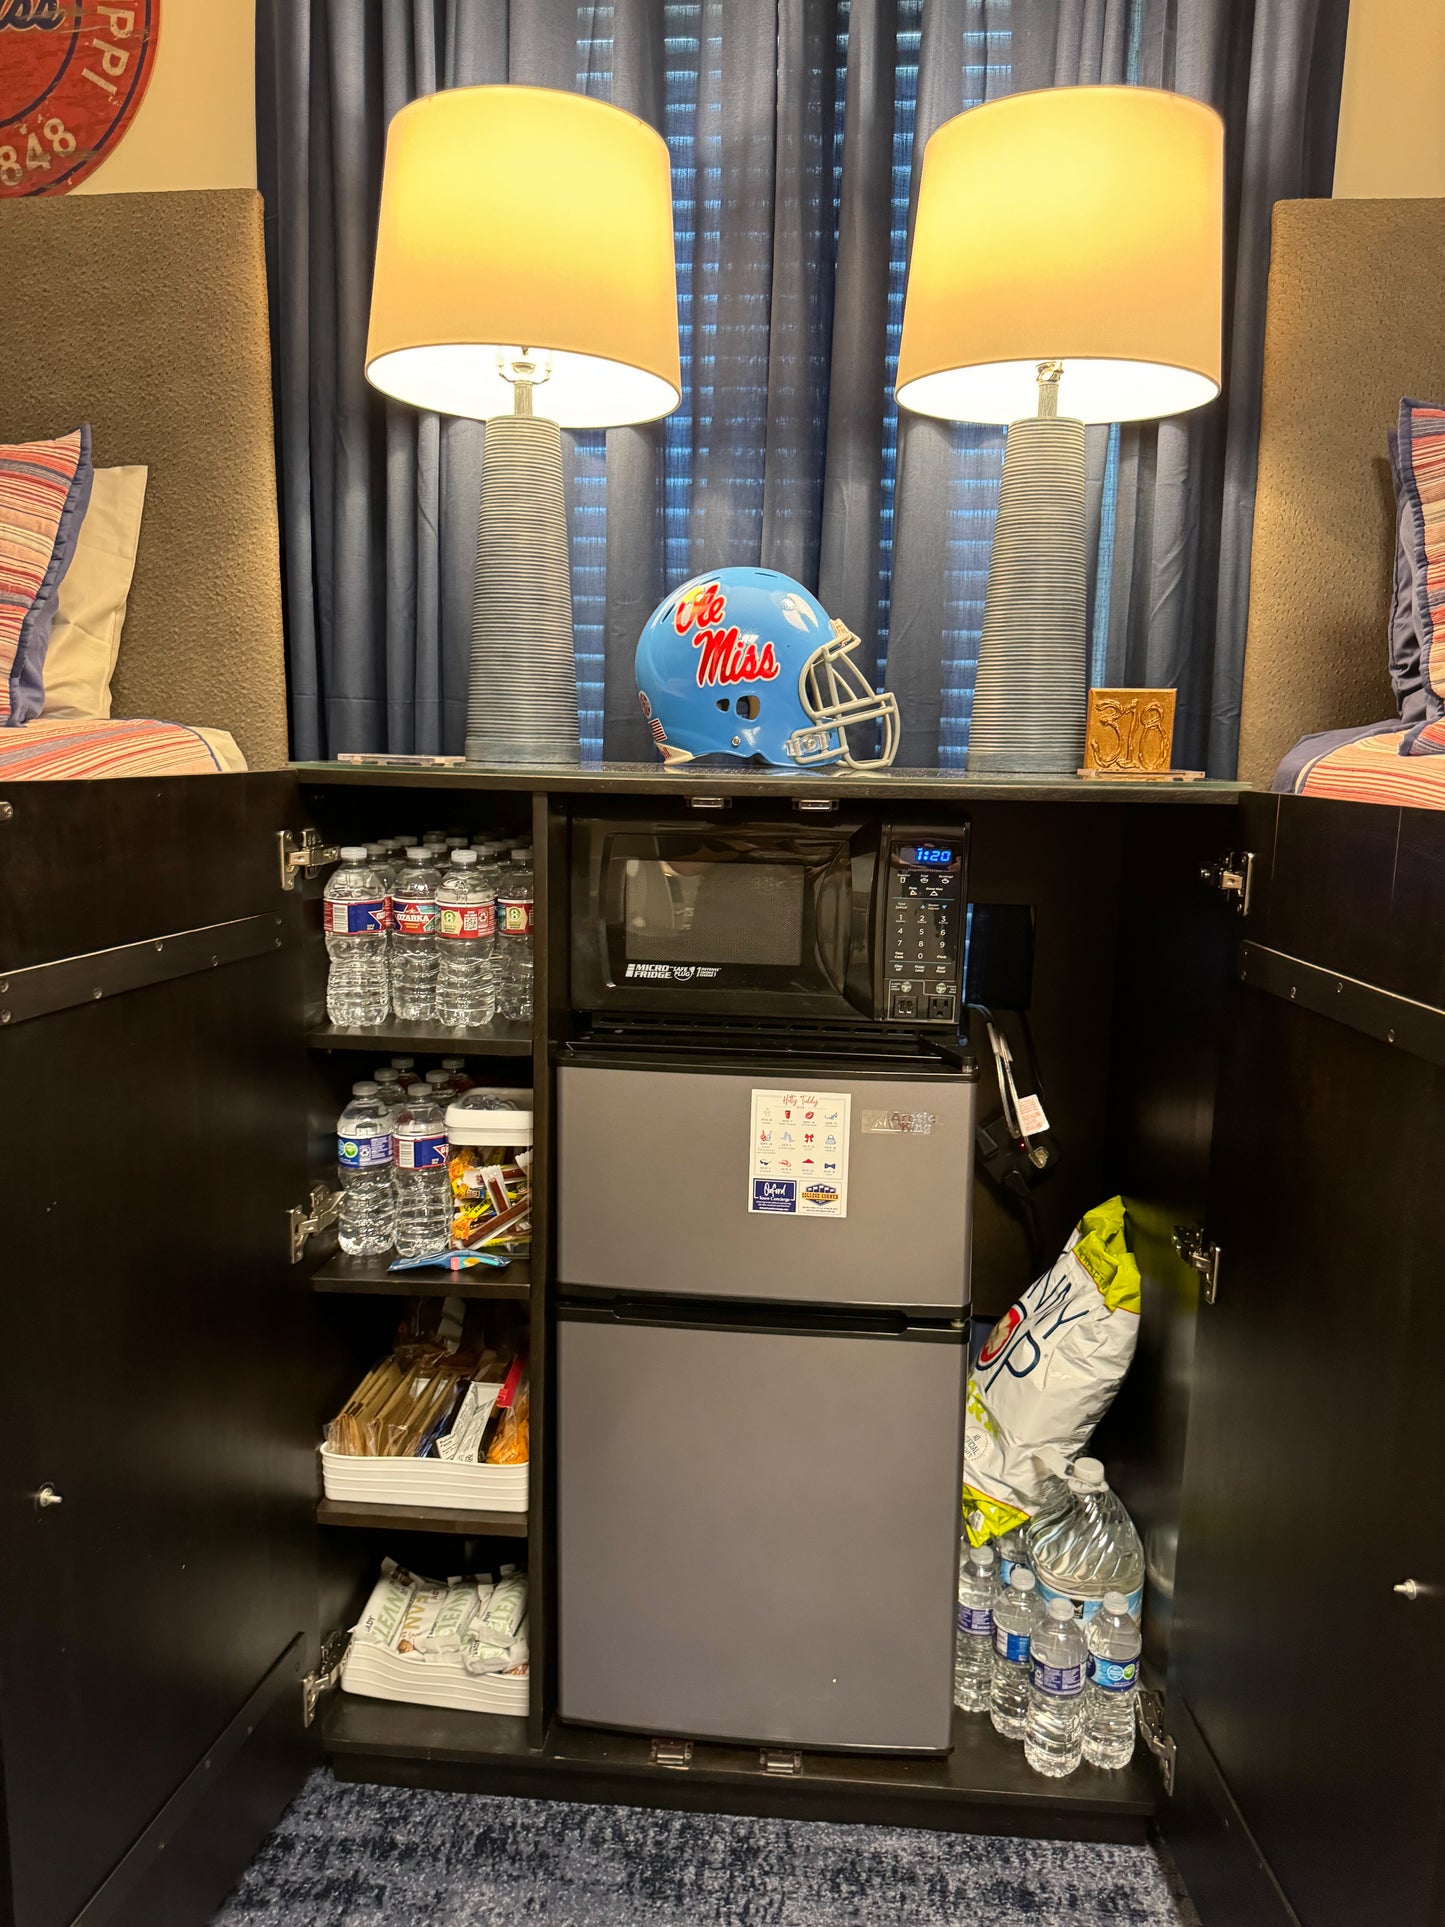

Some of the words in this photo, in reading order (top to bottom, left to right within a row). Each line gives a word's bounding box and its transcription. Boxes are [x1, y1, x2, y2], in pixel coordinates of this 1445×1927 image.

[674, 582, 726, 637] Ole
[693, 626, 781, 689] Miss
[916, 847, 952, 862] 1:20
[396, 913, 430, 922] OZARKA
[636, 963, 670, 972] MICRO
[634, 971, 673, 979] FRIDGE
[890, 1111, 936, 1124] Arctic
[900, 1121, 931, 1134] King
[763, 1182, 787, 1198] Oxford
